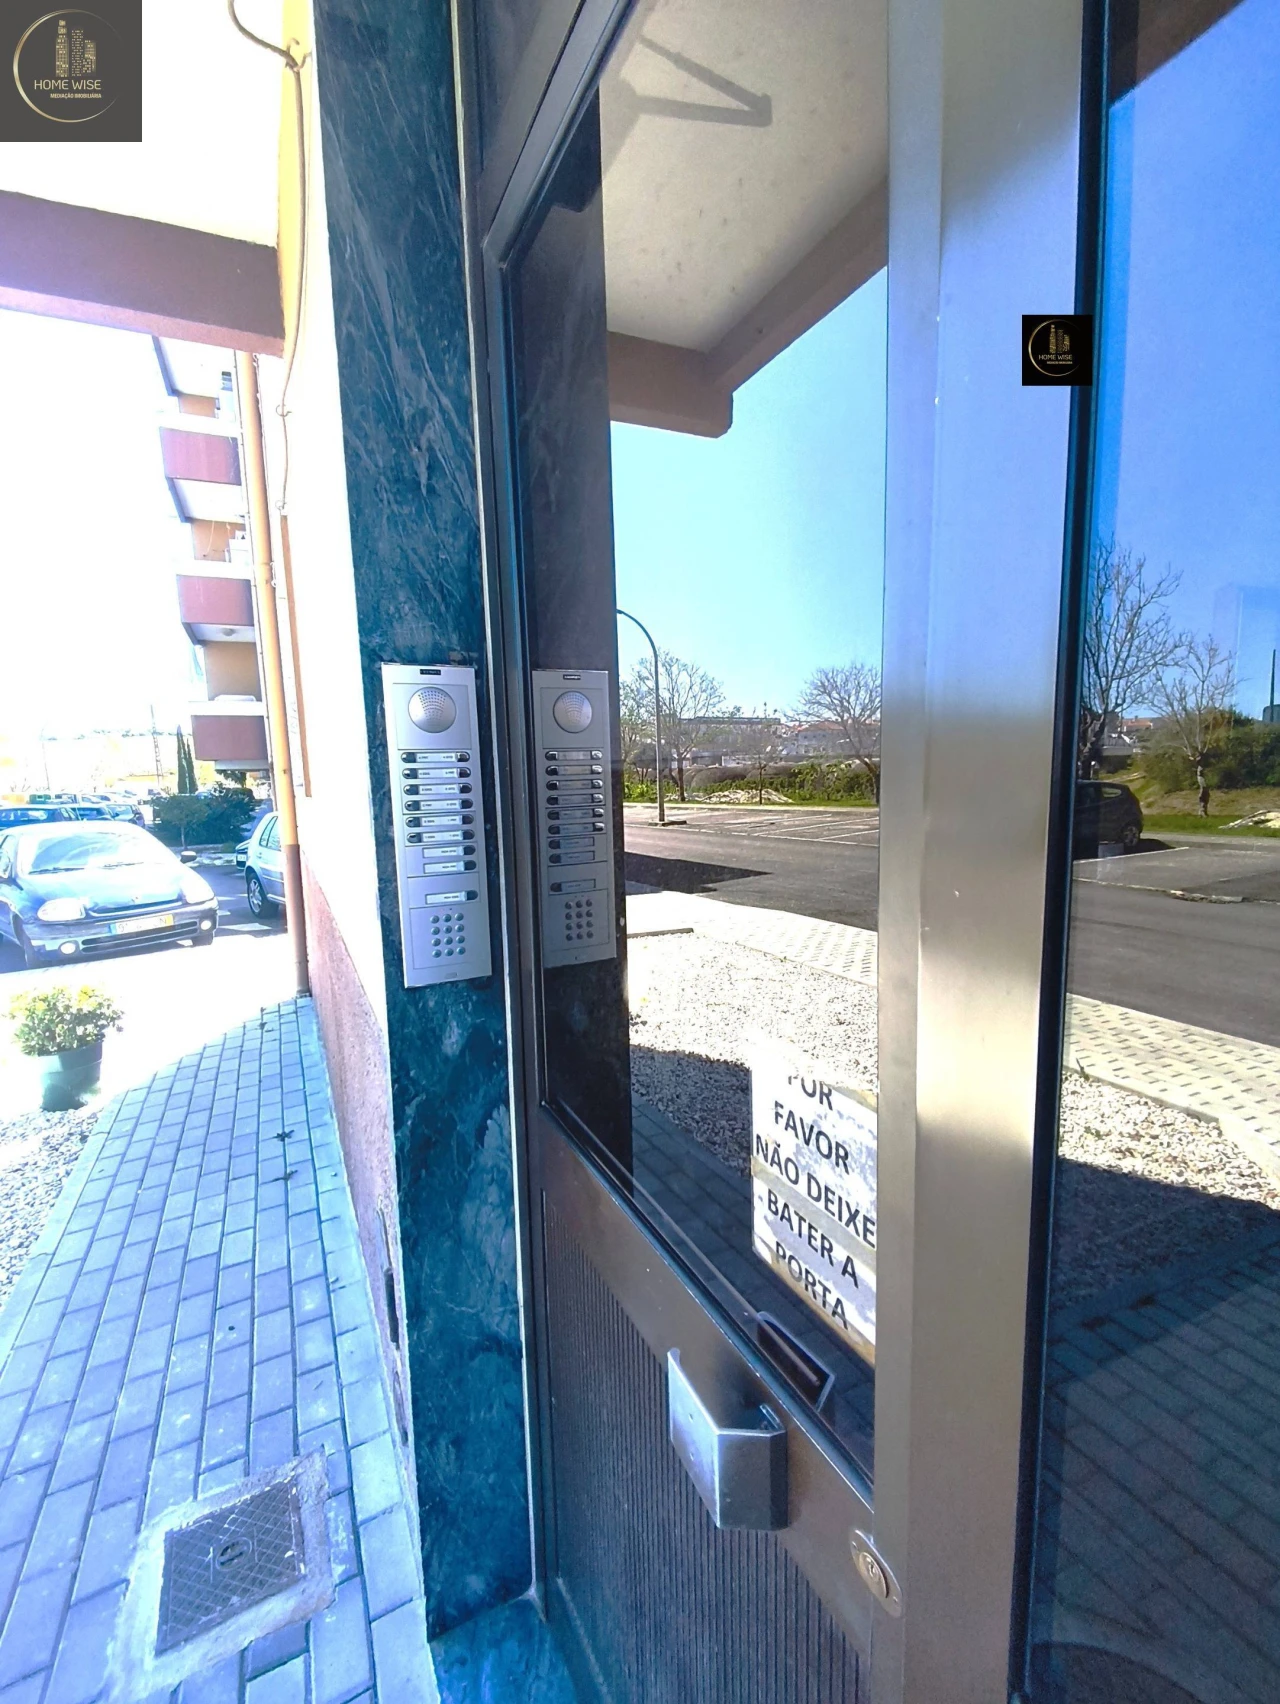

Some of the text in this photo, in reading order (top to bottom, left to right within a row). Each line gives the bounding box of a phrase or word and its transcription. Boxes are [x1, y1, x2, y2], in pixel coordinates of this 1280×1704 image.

[774, 1100, 850, 1175] FAVOR
[756, 1133, 876, 1249] NÃO DEIXE
[767, 1188, 859, 1289] BATER A
[775, 1240, 848, 1330] PORTA
